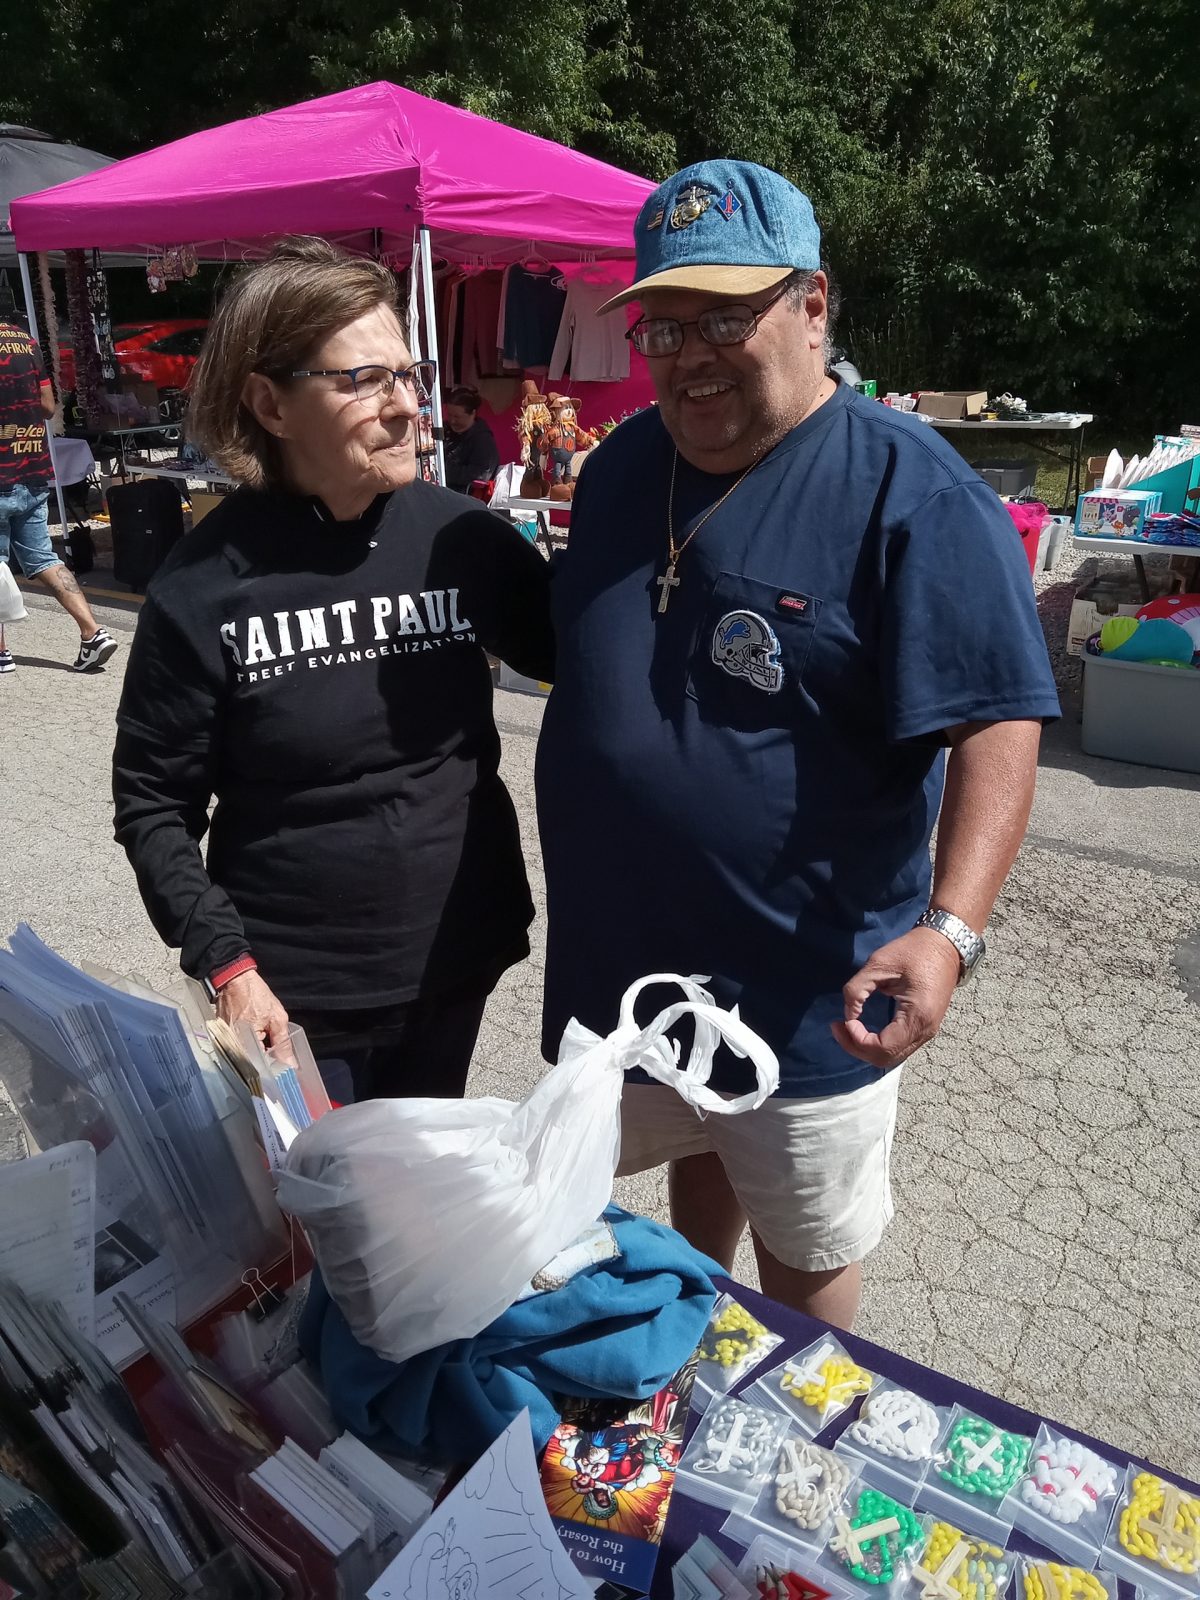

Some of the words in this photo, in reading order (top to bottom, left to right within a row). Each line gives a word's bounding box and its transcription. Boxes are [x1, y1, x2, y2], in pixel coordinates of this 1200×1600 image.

[220, 600, 357, 665] SAINT
[370, 588, 473, 640] PAUL
[236, 661, 296, 683] TREET
[308, 632, 476, 669] EVANGELIZATION
[557, 1525, 600, 1549] Rosary
[602, 1540, 624, 1554] the
[576, 1550, 590, 1560] to
[592, 1555, 627, 1574] How
